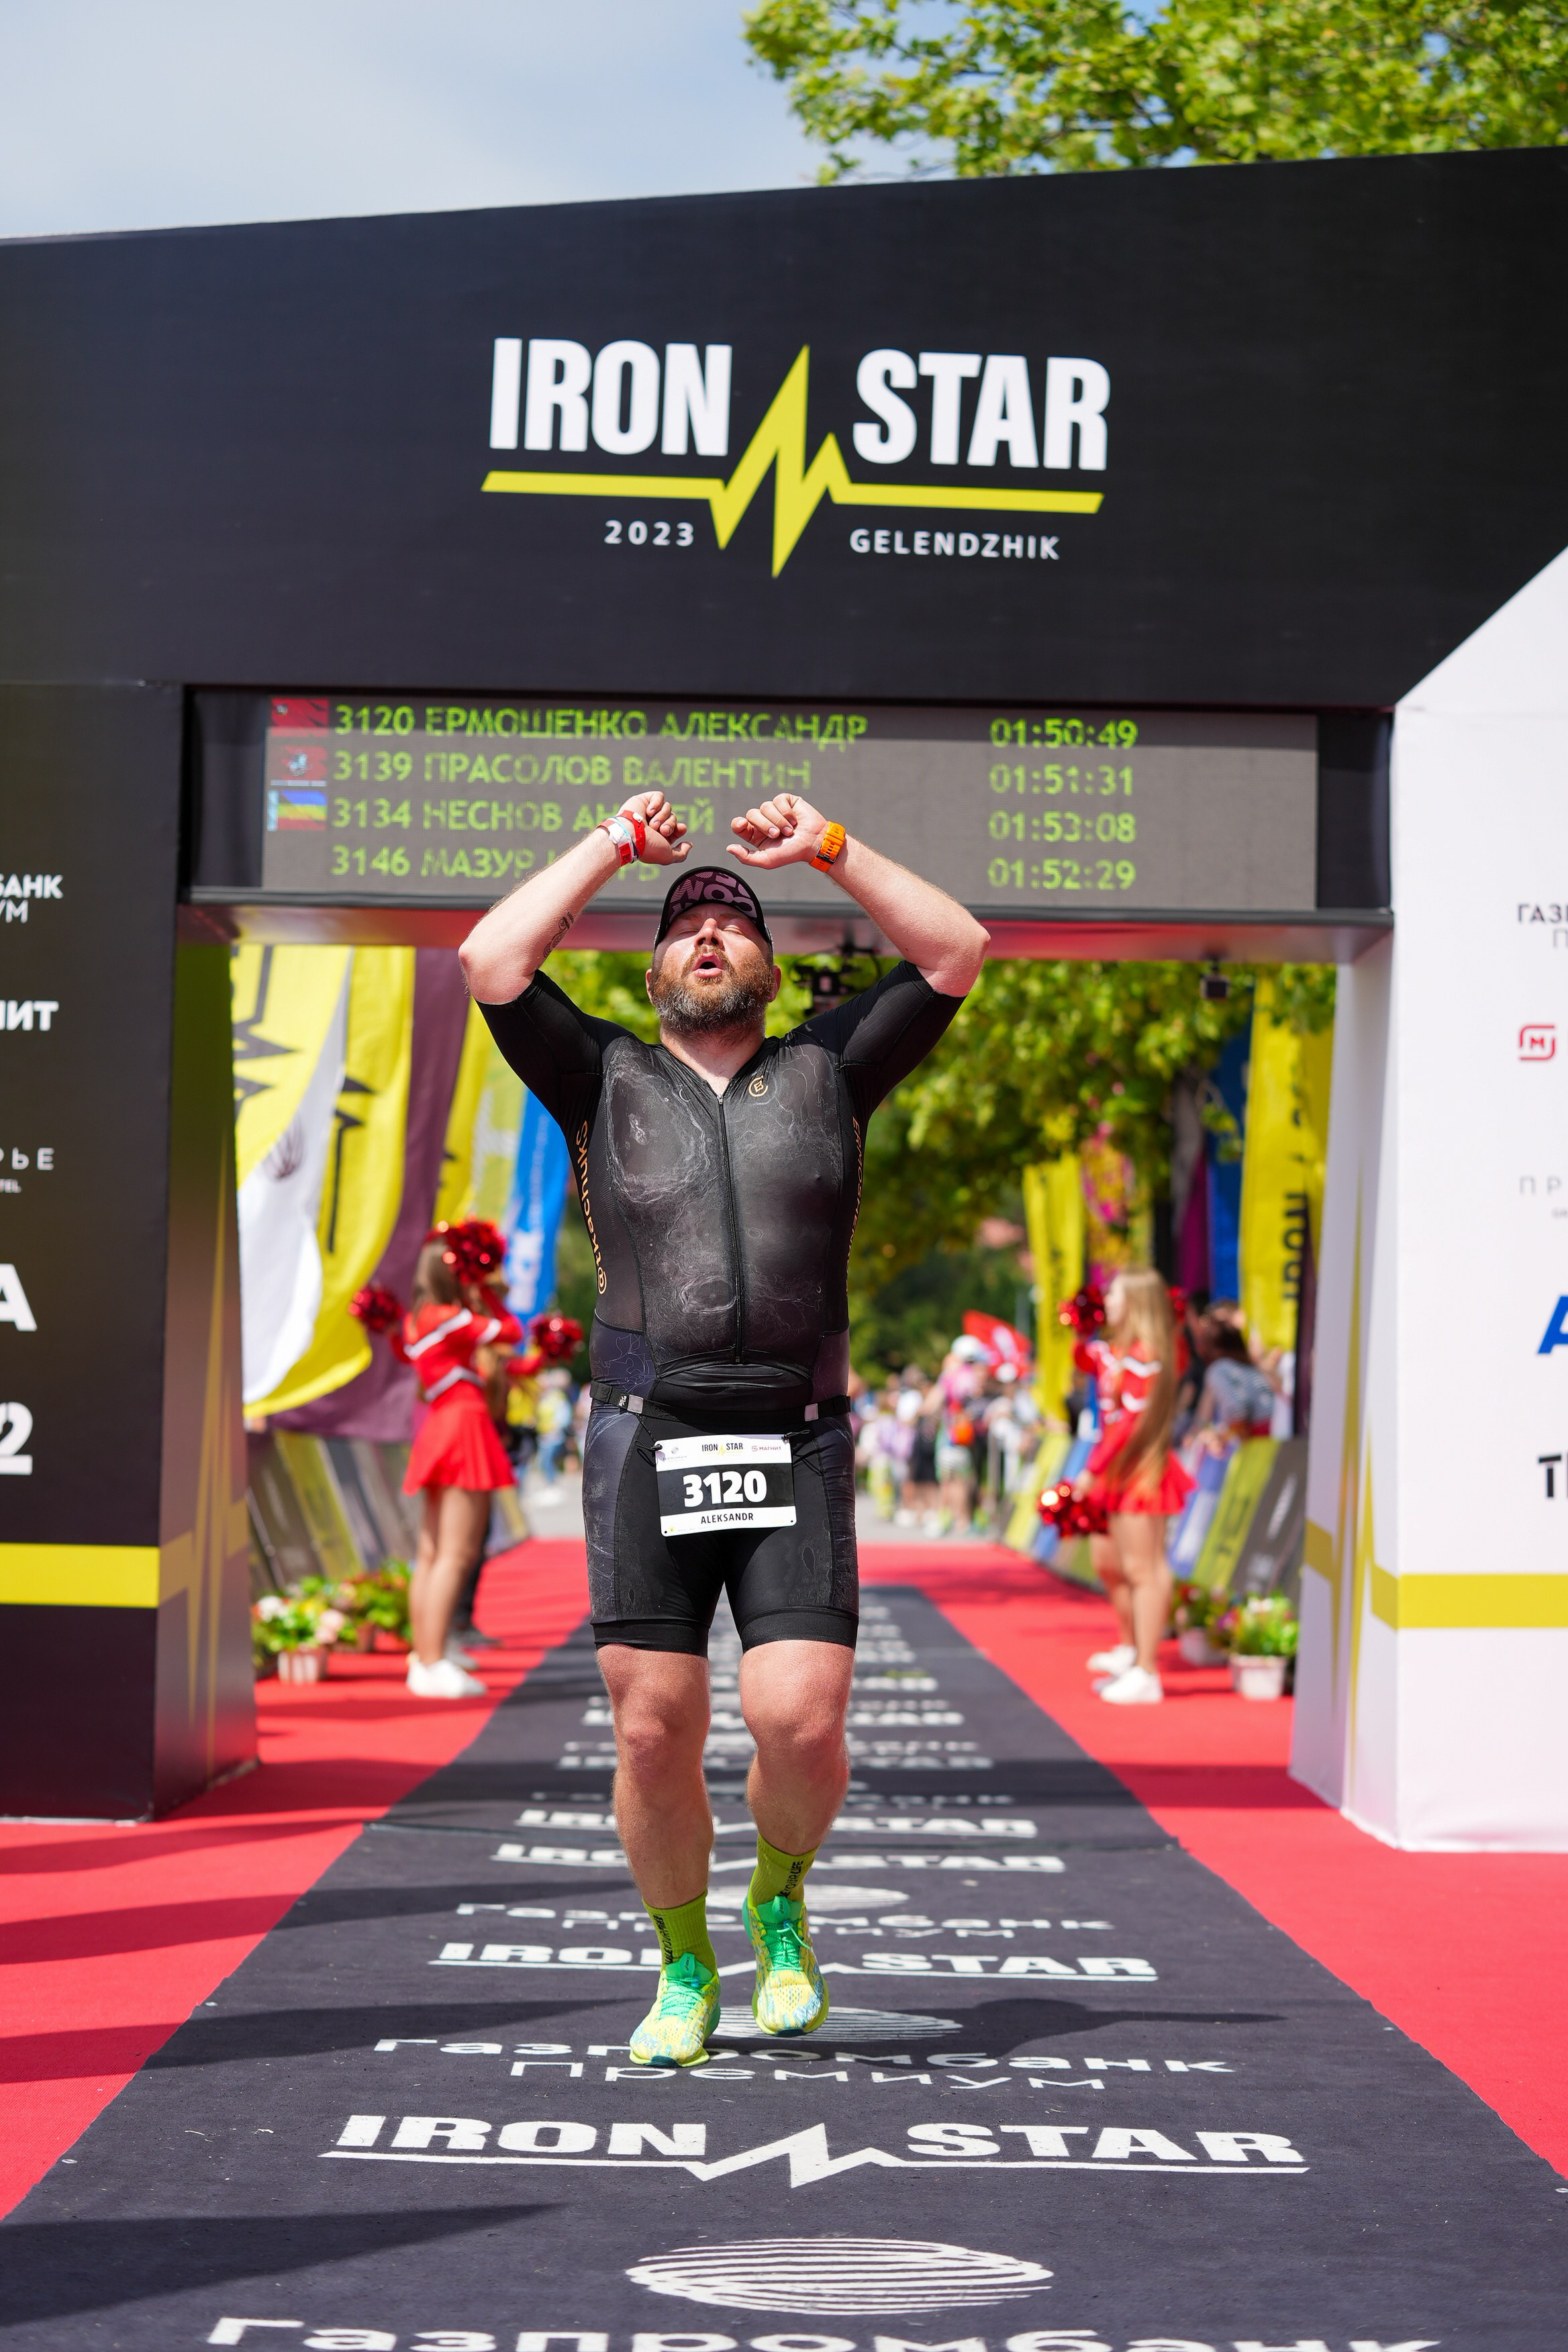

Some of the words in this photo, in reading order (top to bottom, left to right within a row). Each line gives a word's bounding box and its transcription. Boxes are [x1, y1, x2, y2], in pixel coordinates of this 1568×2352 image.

[489, 337, 732, 456] IRON
[852, 348, 1111, 471] STAR
[603, 520, 695, 546] 2023
[849, 528, 1060, 560] GELENDZHIK
[336, 705, 415, 736] 3120
[425, 707, 648, 739] ЕРМОШЕНКО
[660, 711, 868, 752] АЛЕКСАНДР
[990, 718, 1137, 750] 01:50:49
[334, 750, 413, 781] 3139
[424, 751, 612, 786] ПРАСОЛОВ
[623, 755, 812, 789] ВАЛЕНТИН
[989, 764, 1134, 796] 01:51:31
[332, 797, 412, 829] 3134
[422, 799, 562, 832] НЕСНОВ
[989, 812, 1136, 844] 01:53:08
[0, 873, 64, 899] АНК
[331, 844, 411, 876] 3146
[421, 846, 536, 879] МАЗУР
[989, 859, 1136, 890] 01:52:29
[1518, 903, 1568, 924] ГАЗ
[701, 1443, 718, 1452] IRON
[726, 1442, 743, 1451] STAR
[683, 1470, 767, 1508] 3120
[701, 1512, 754, 1524] ALEKSANDR
[862, 1953, 1157, 1975] STAR
[509, 2061, 1105, 2090] Премиум
[337, 2115, 707, 2156] IRON
[908, 2123, 1305, 2163] STAR
